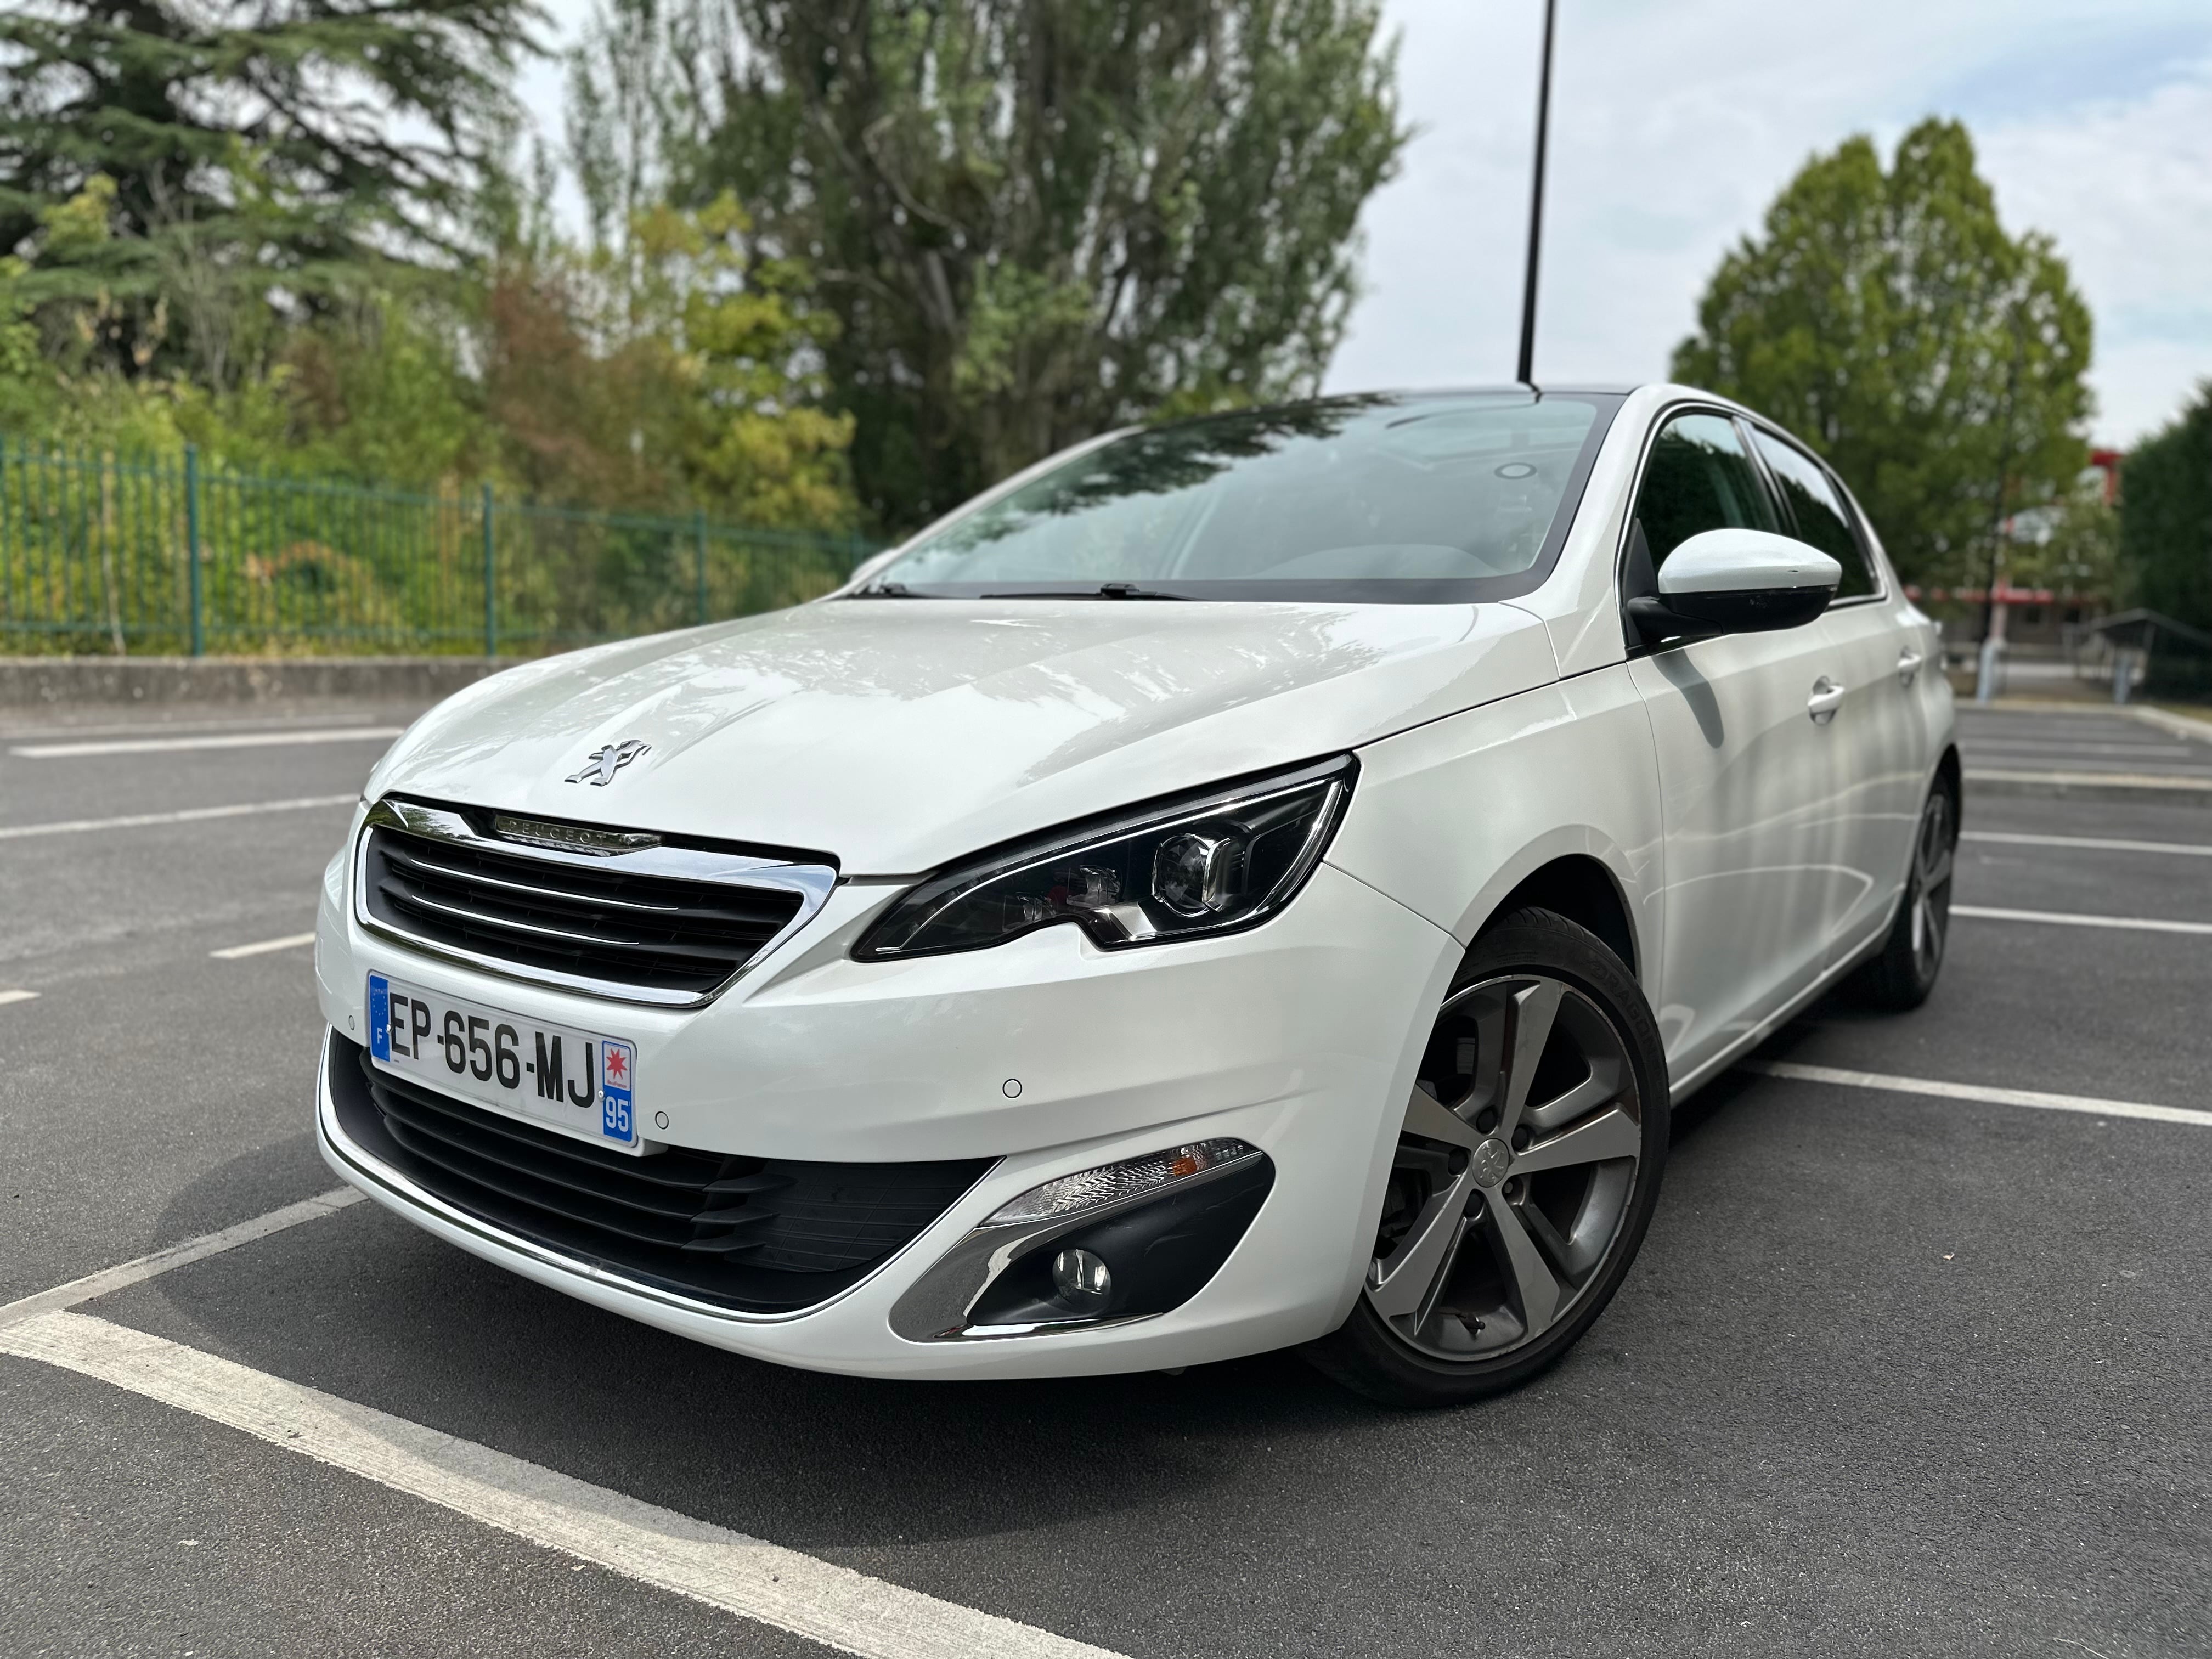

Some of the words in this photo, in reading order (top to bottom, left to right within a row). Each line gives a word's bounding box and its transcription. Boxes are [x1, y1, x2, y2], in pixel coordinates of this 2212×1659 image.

[509, 820, 606, 845] PEUGEOT
[377, 1027, 382, 1044] F
[390, 992, 595, 1108] EP-656-MJ
[606, 1096, 629, 1133] 95
